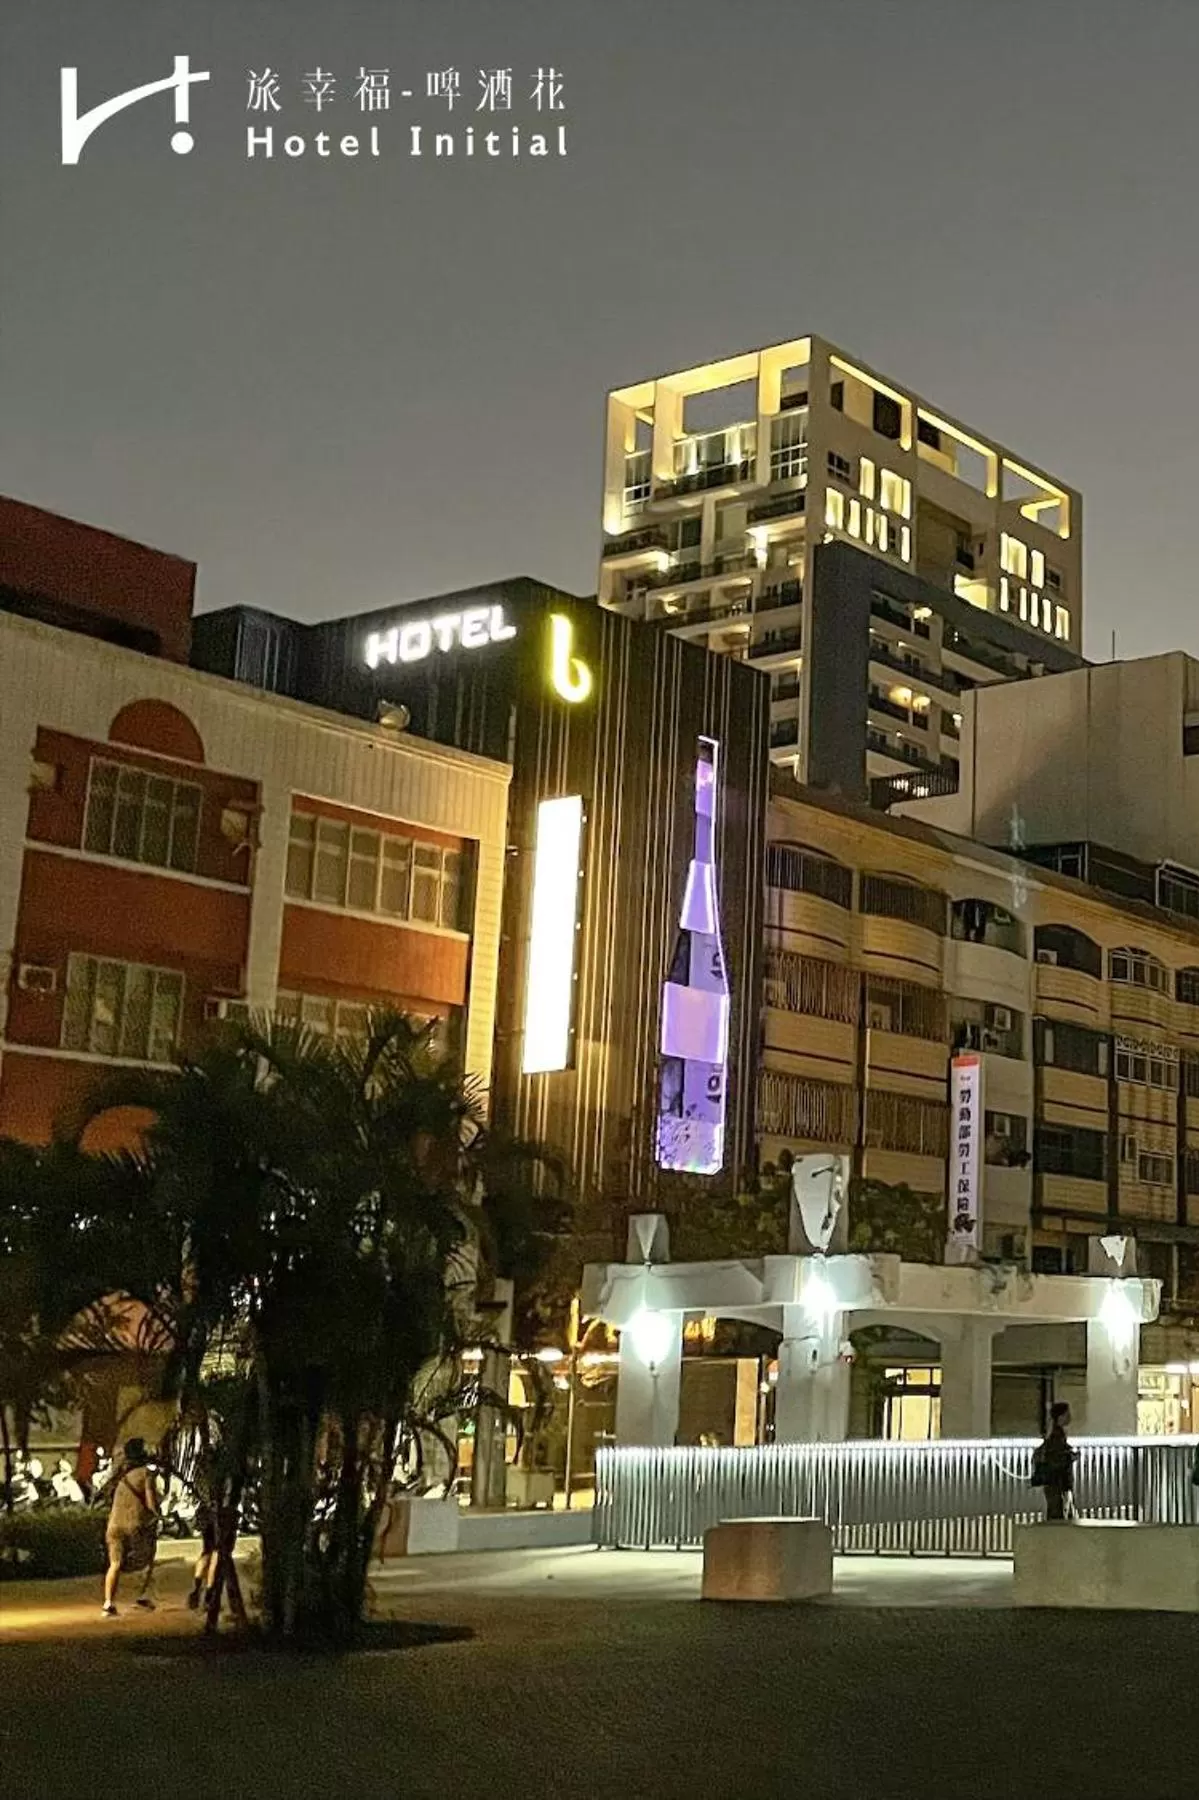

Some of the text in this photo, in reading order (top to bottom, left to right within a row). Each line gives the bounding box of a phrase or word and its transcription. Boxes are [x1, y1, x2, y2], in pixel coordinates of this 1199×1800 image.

[363, 603, 517, 671] HOTEL
[957, 1088, 973, 1232] 勞動部勞工保險
